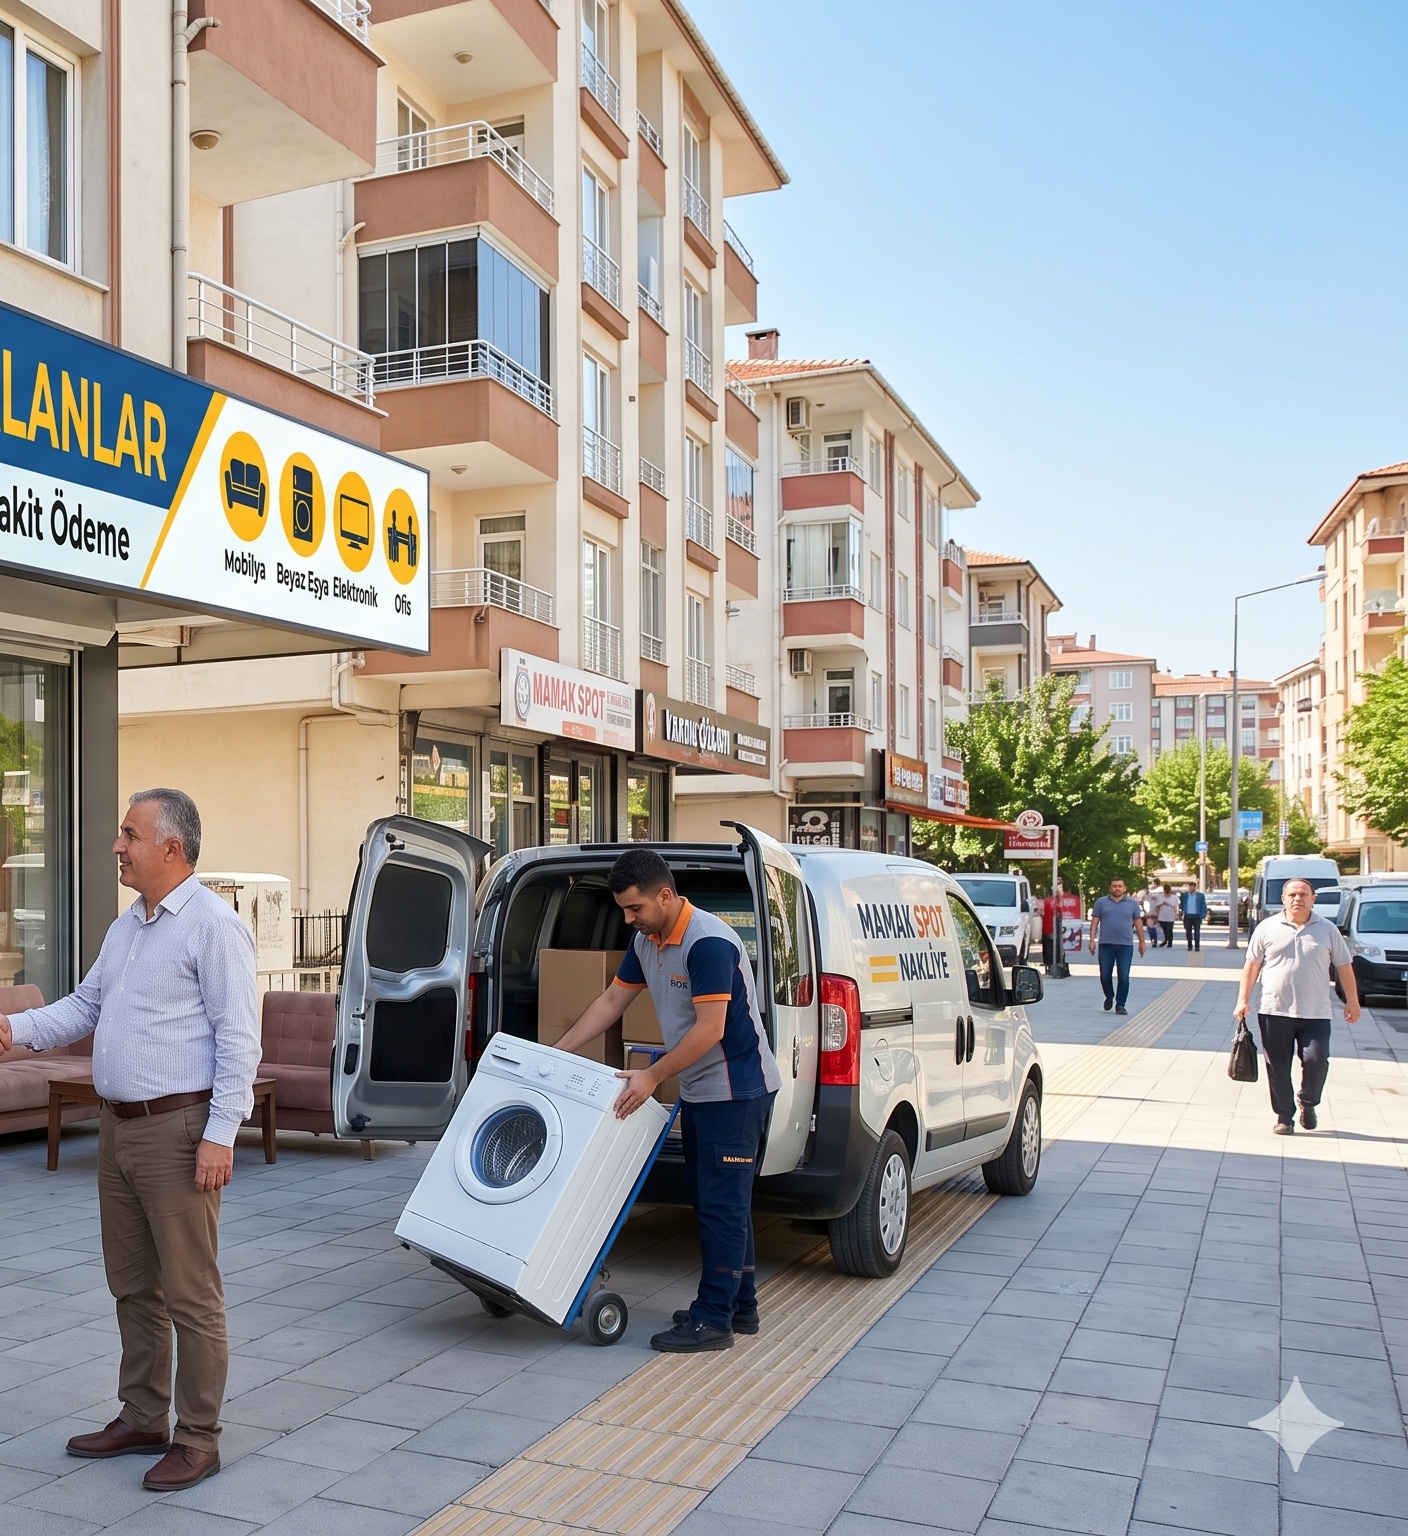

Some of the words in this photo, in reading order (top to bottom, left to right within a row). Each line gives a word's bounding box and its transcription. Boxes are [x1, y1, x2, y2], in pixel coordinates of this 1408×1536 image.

[51, 498, 130, 562] Ödeme
[224, 548, 267, 585] Mobilya
[276, 562, 306, 593] Beyaz
[307, 570, 330, 600] Eşya
[333, 576, 379, 608] Elektronik
[394, 593, 413, 616] Ofis
[533, 671, 576, 714] MAMAK
[577, 684, 606, 720] SPOT
[856, 903, 916, 939] MAMAK
[913, 904, 946, 939] SPOT
[898, 942, 950, 981] NAKLİYE
